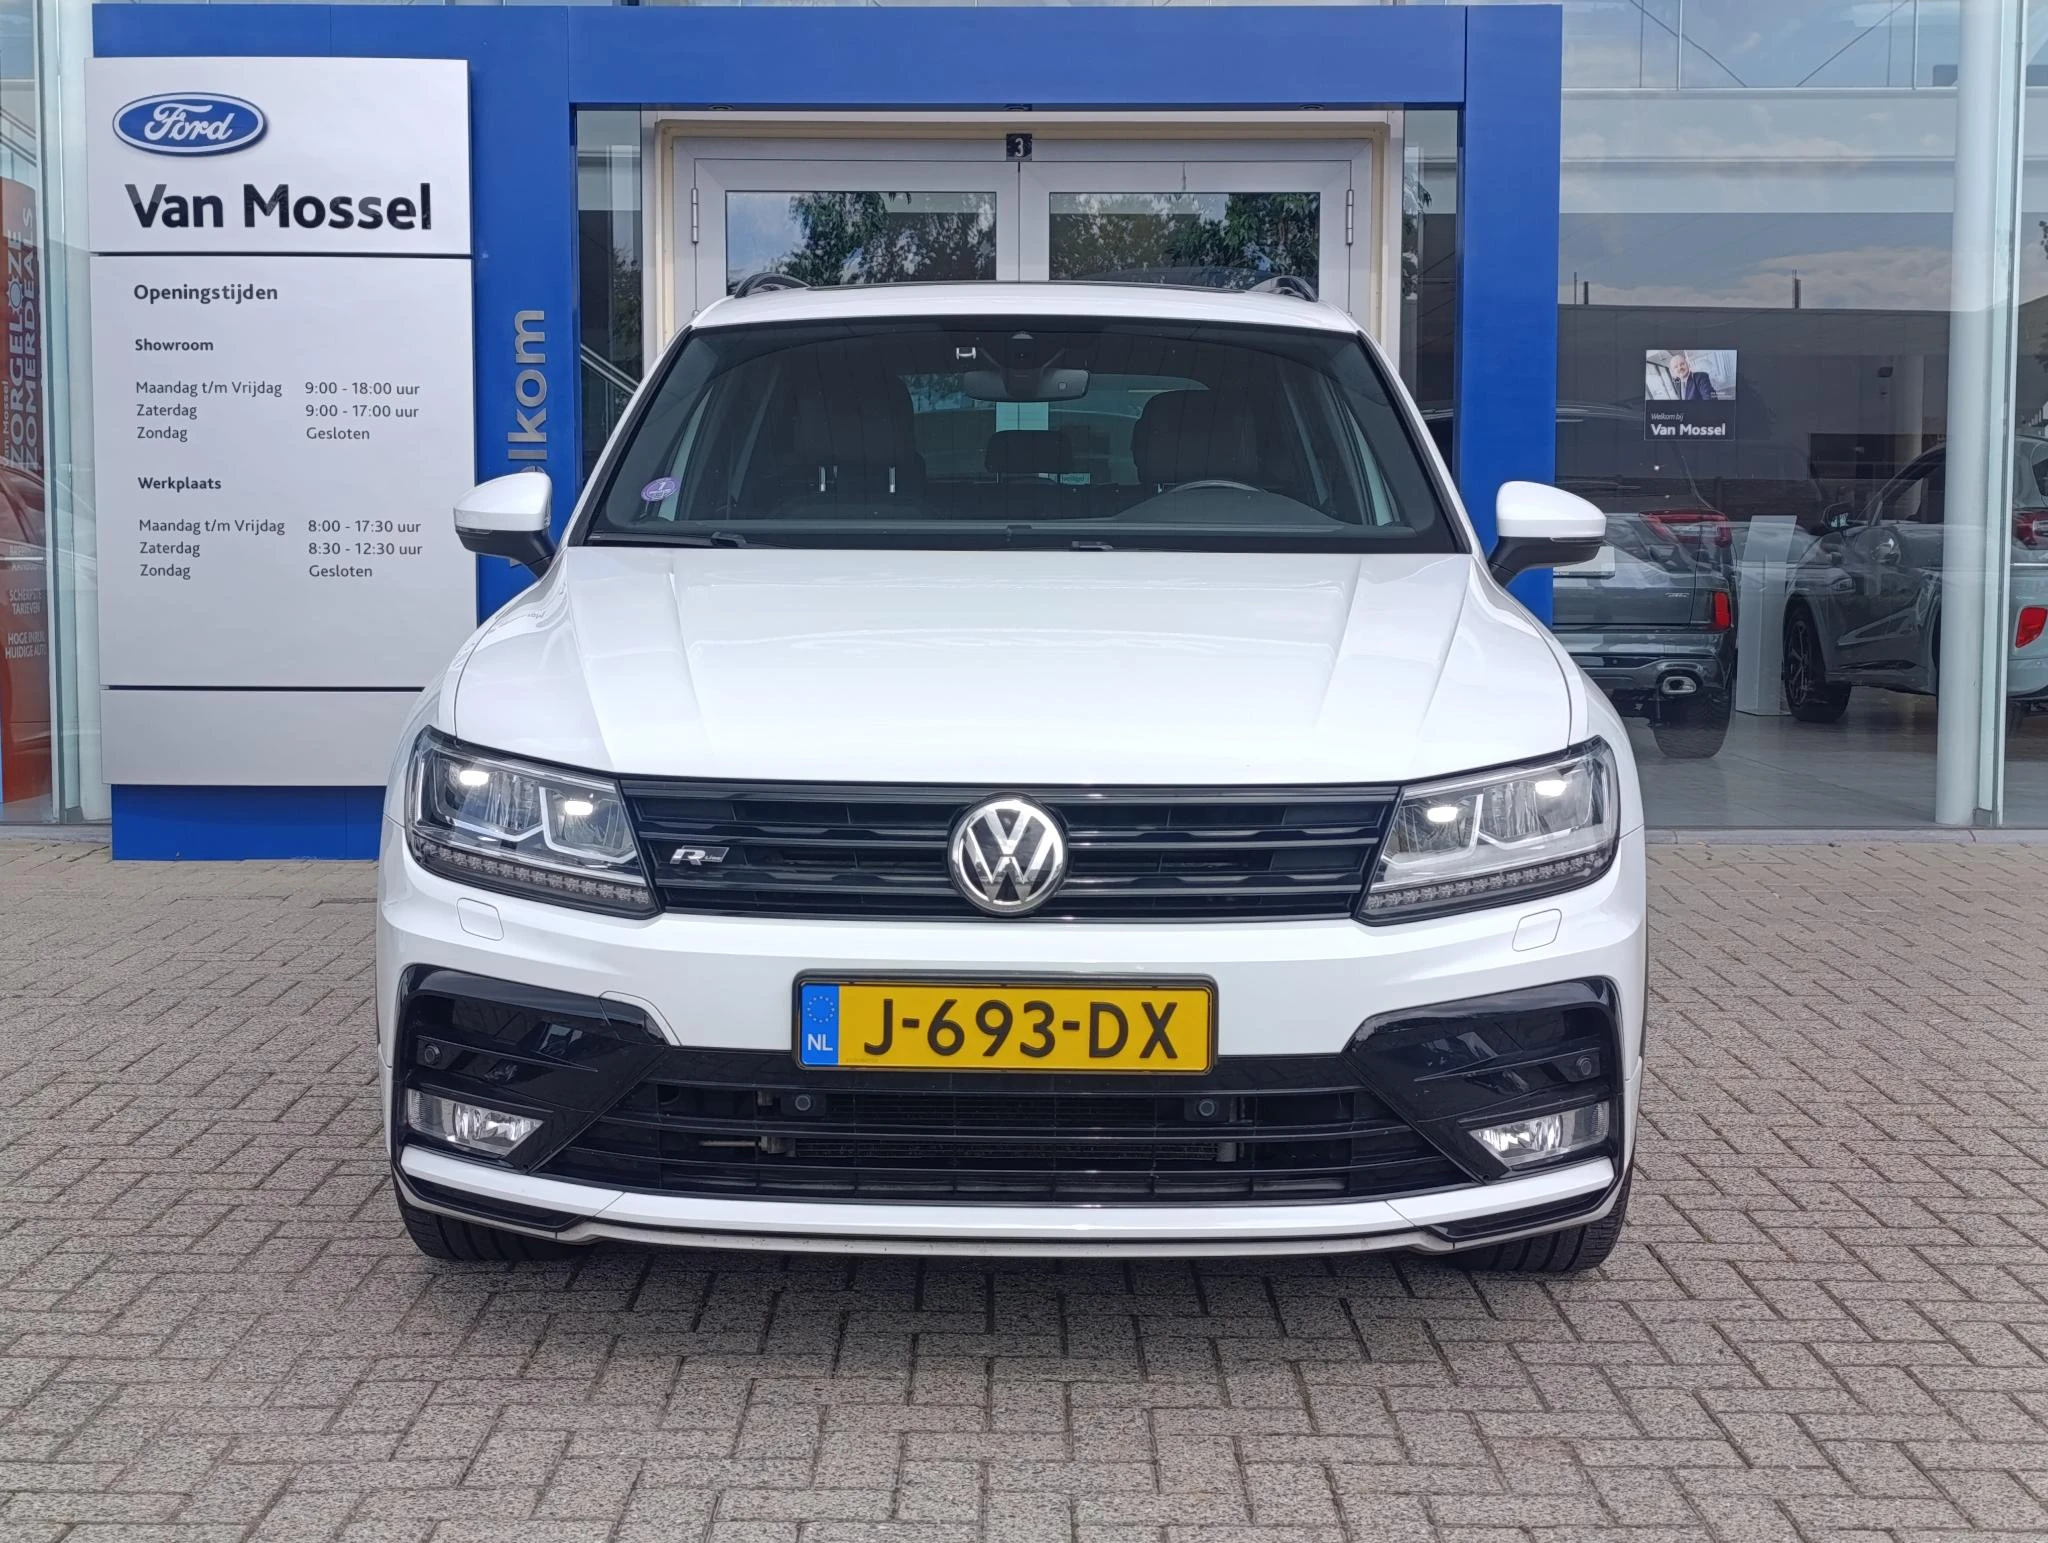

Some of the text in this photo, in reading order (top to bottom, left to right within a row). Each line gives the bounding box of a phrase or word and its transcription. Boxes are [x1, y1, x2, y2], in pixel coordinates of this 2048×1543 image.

[143, 103, 236, 141] Ford
[1015, 137, 1024, 157] 3
[124, 182, 432, 231] Van Mossel
[133, 283, 279, 305] Openingstijden
[134, 337, 214, 352] Showroom
[136, 380, 199, 398] Maandag
[201, 380, 228, 396] t/m
[231, 381, 283, 399] Vrijdag
[304, 381, 338, 396] 9:00
[351, 381, 392, 396] 18:00
[395, 385, 421, 396] uur
[136, 403, 198, 421] Zaterdag
[305, 403, 339, 418] 9:00
[352, 403, 392, 418] 17:00
[395, 407, 420, 418] uur
[136, 425, 371, 443] Zondag Gesloten
[1651, 422, 1726, 436] Van Mossel
[137, 475, 222, 494] Werkplaats
[139, 518, 202, 536] Maandag
[204, 518, 231, 534] t/m
[234, 518, 286, 537] Vrijdag
[307, 519, 341, 533] 8:00
[354, 519, 394, 533] 17:30
[397, 523, 422, 533] uur
[139, 540, 201, 558] Zaterdag
[308, 541, 341, 555] 8:30
[354, 542, 395, 556] 12:30
[398, 545, 423, 556] uur
[139, 563, 373, 580] Zondag Gesloten
[863, 999, 1178, 1059] J-693-DX
[807, 1033, 833, 1051] NL
